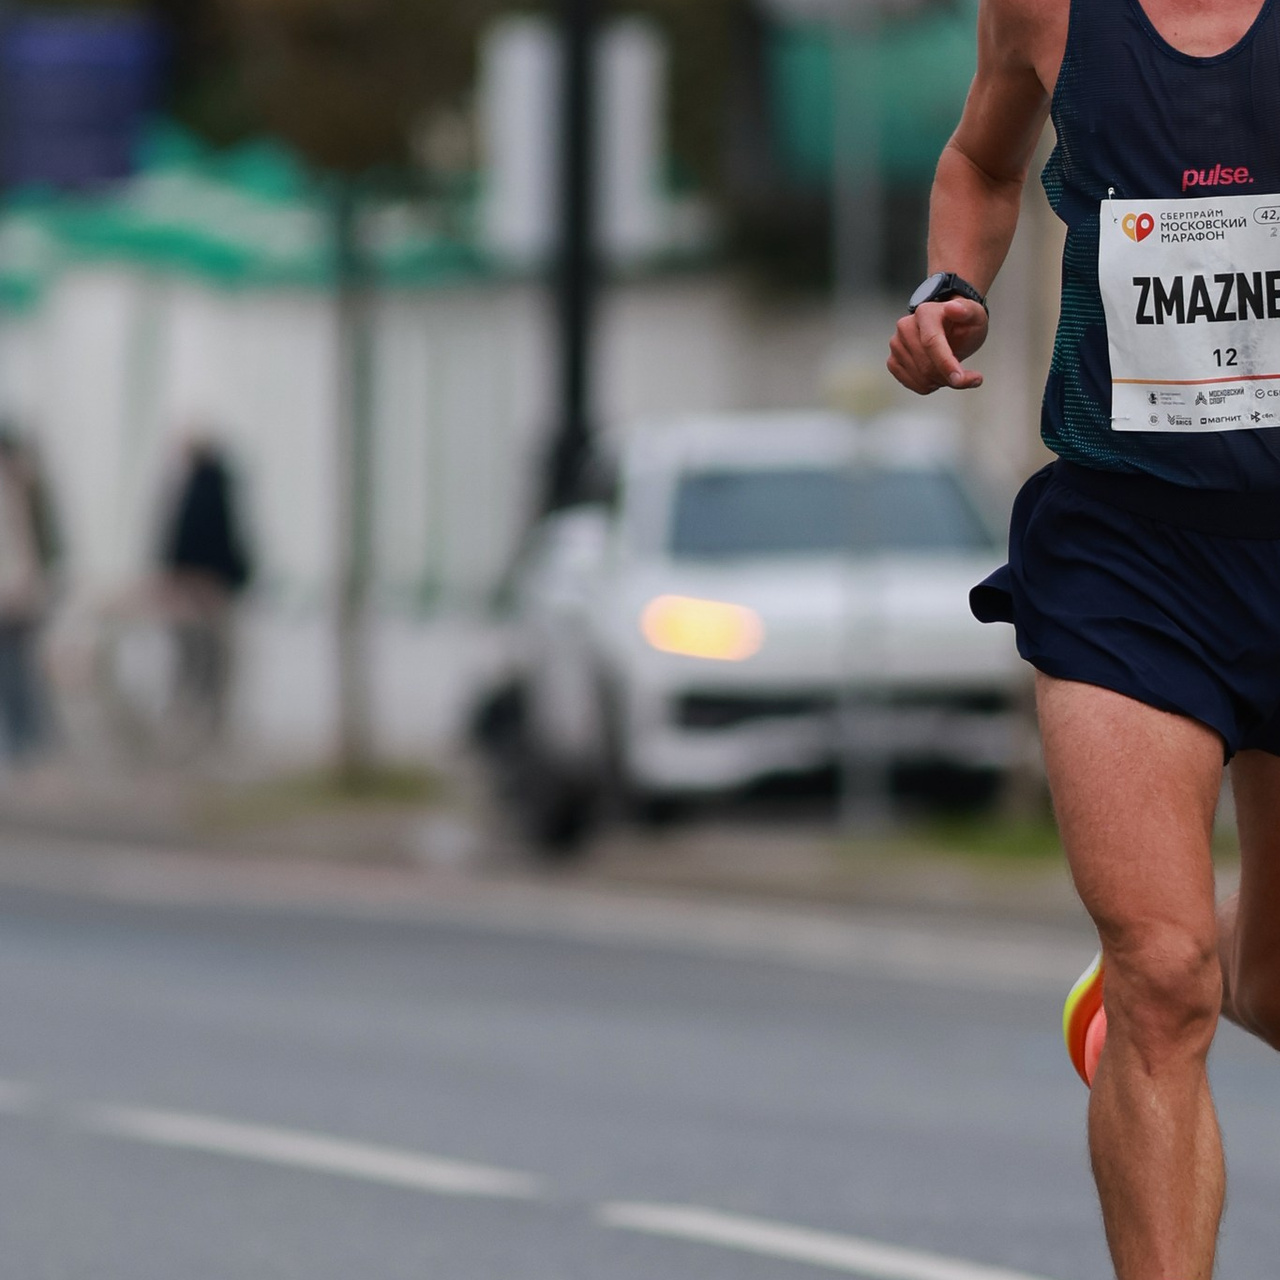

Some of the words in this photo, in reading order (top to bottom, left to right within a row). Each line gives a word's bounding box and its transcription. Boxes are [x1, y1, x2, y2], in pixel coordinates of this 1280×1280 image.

[1182, 164, 1254, 192] pulse.
[1160, 208, 1224, 221] СБЕРПРАЙМ
[1160, 217, 1247, 232] МОСКОВСКИЙ
[1161, 231, 1225, 243] МАРАФОН
[1212, 348, 1238, 367] 12
